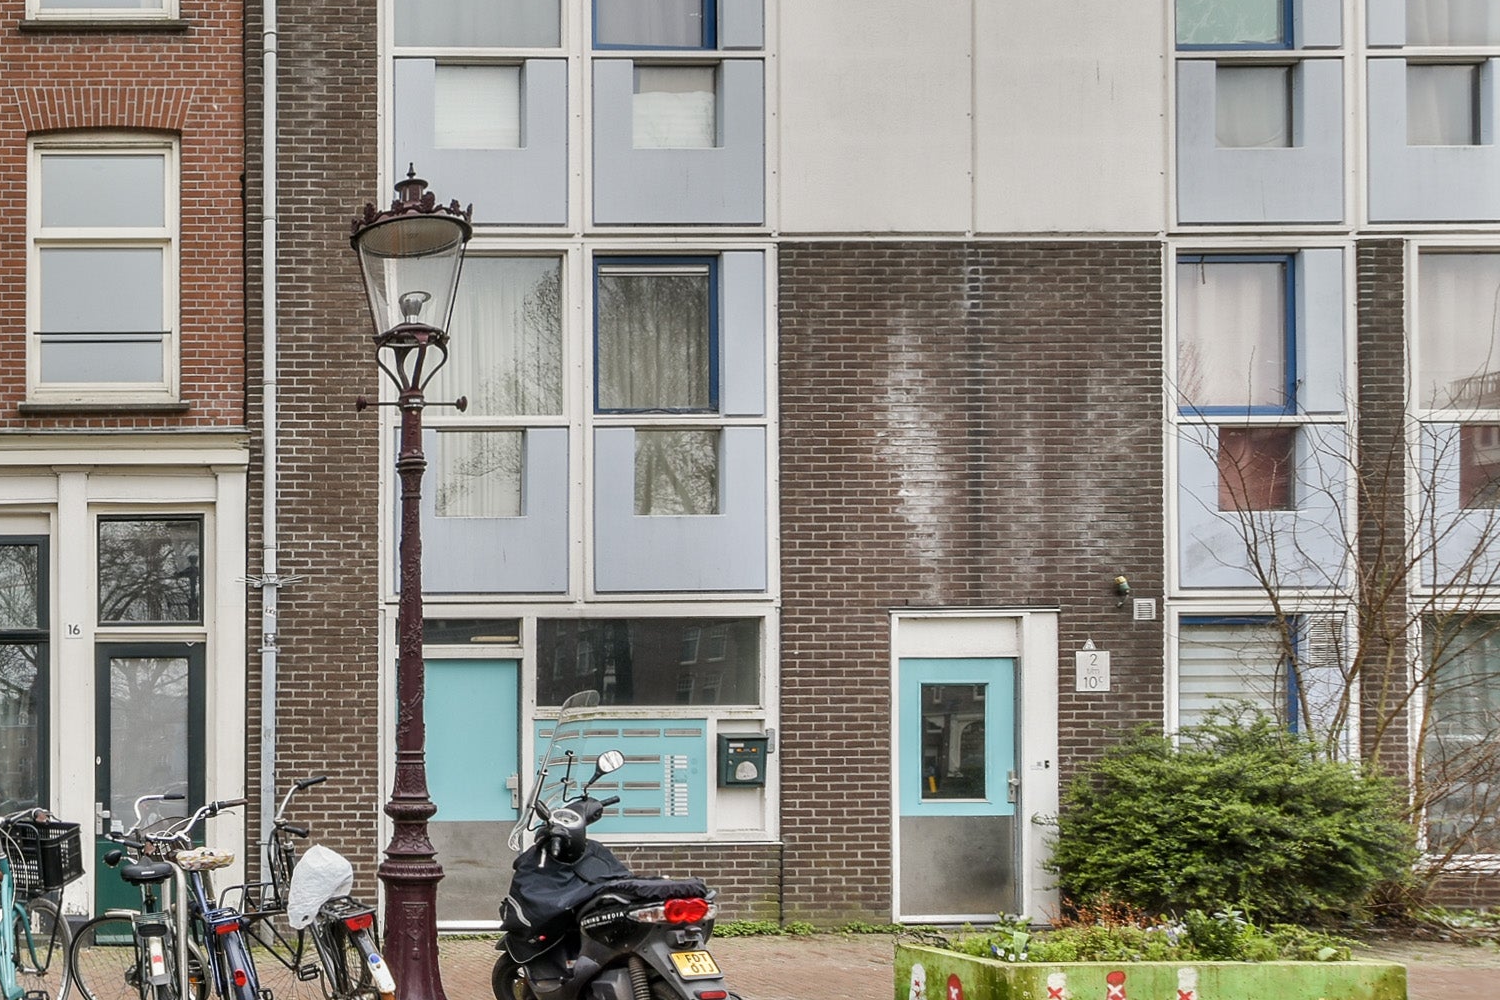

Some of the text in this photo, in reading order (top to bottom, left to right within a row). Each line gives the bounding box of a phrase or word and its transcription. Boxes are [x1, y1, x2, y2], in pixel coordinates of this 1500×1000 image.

[68, 624, 81, 635] 16
[1089, 653, 1098, 667] 2
[601, 911, 625, 921] MEDIA
